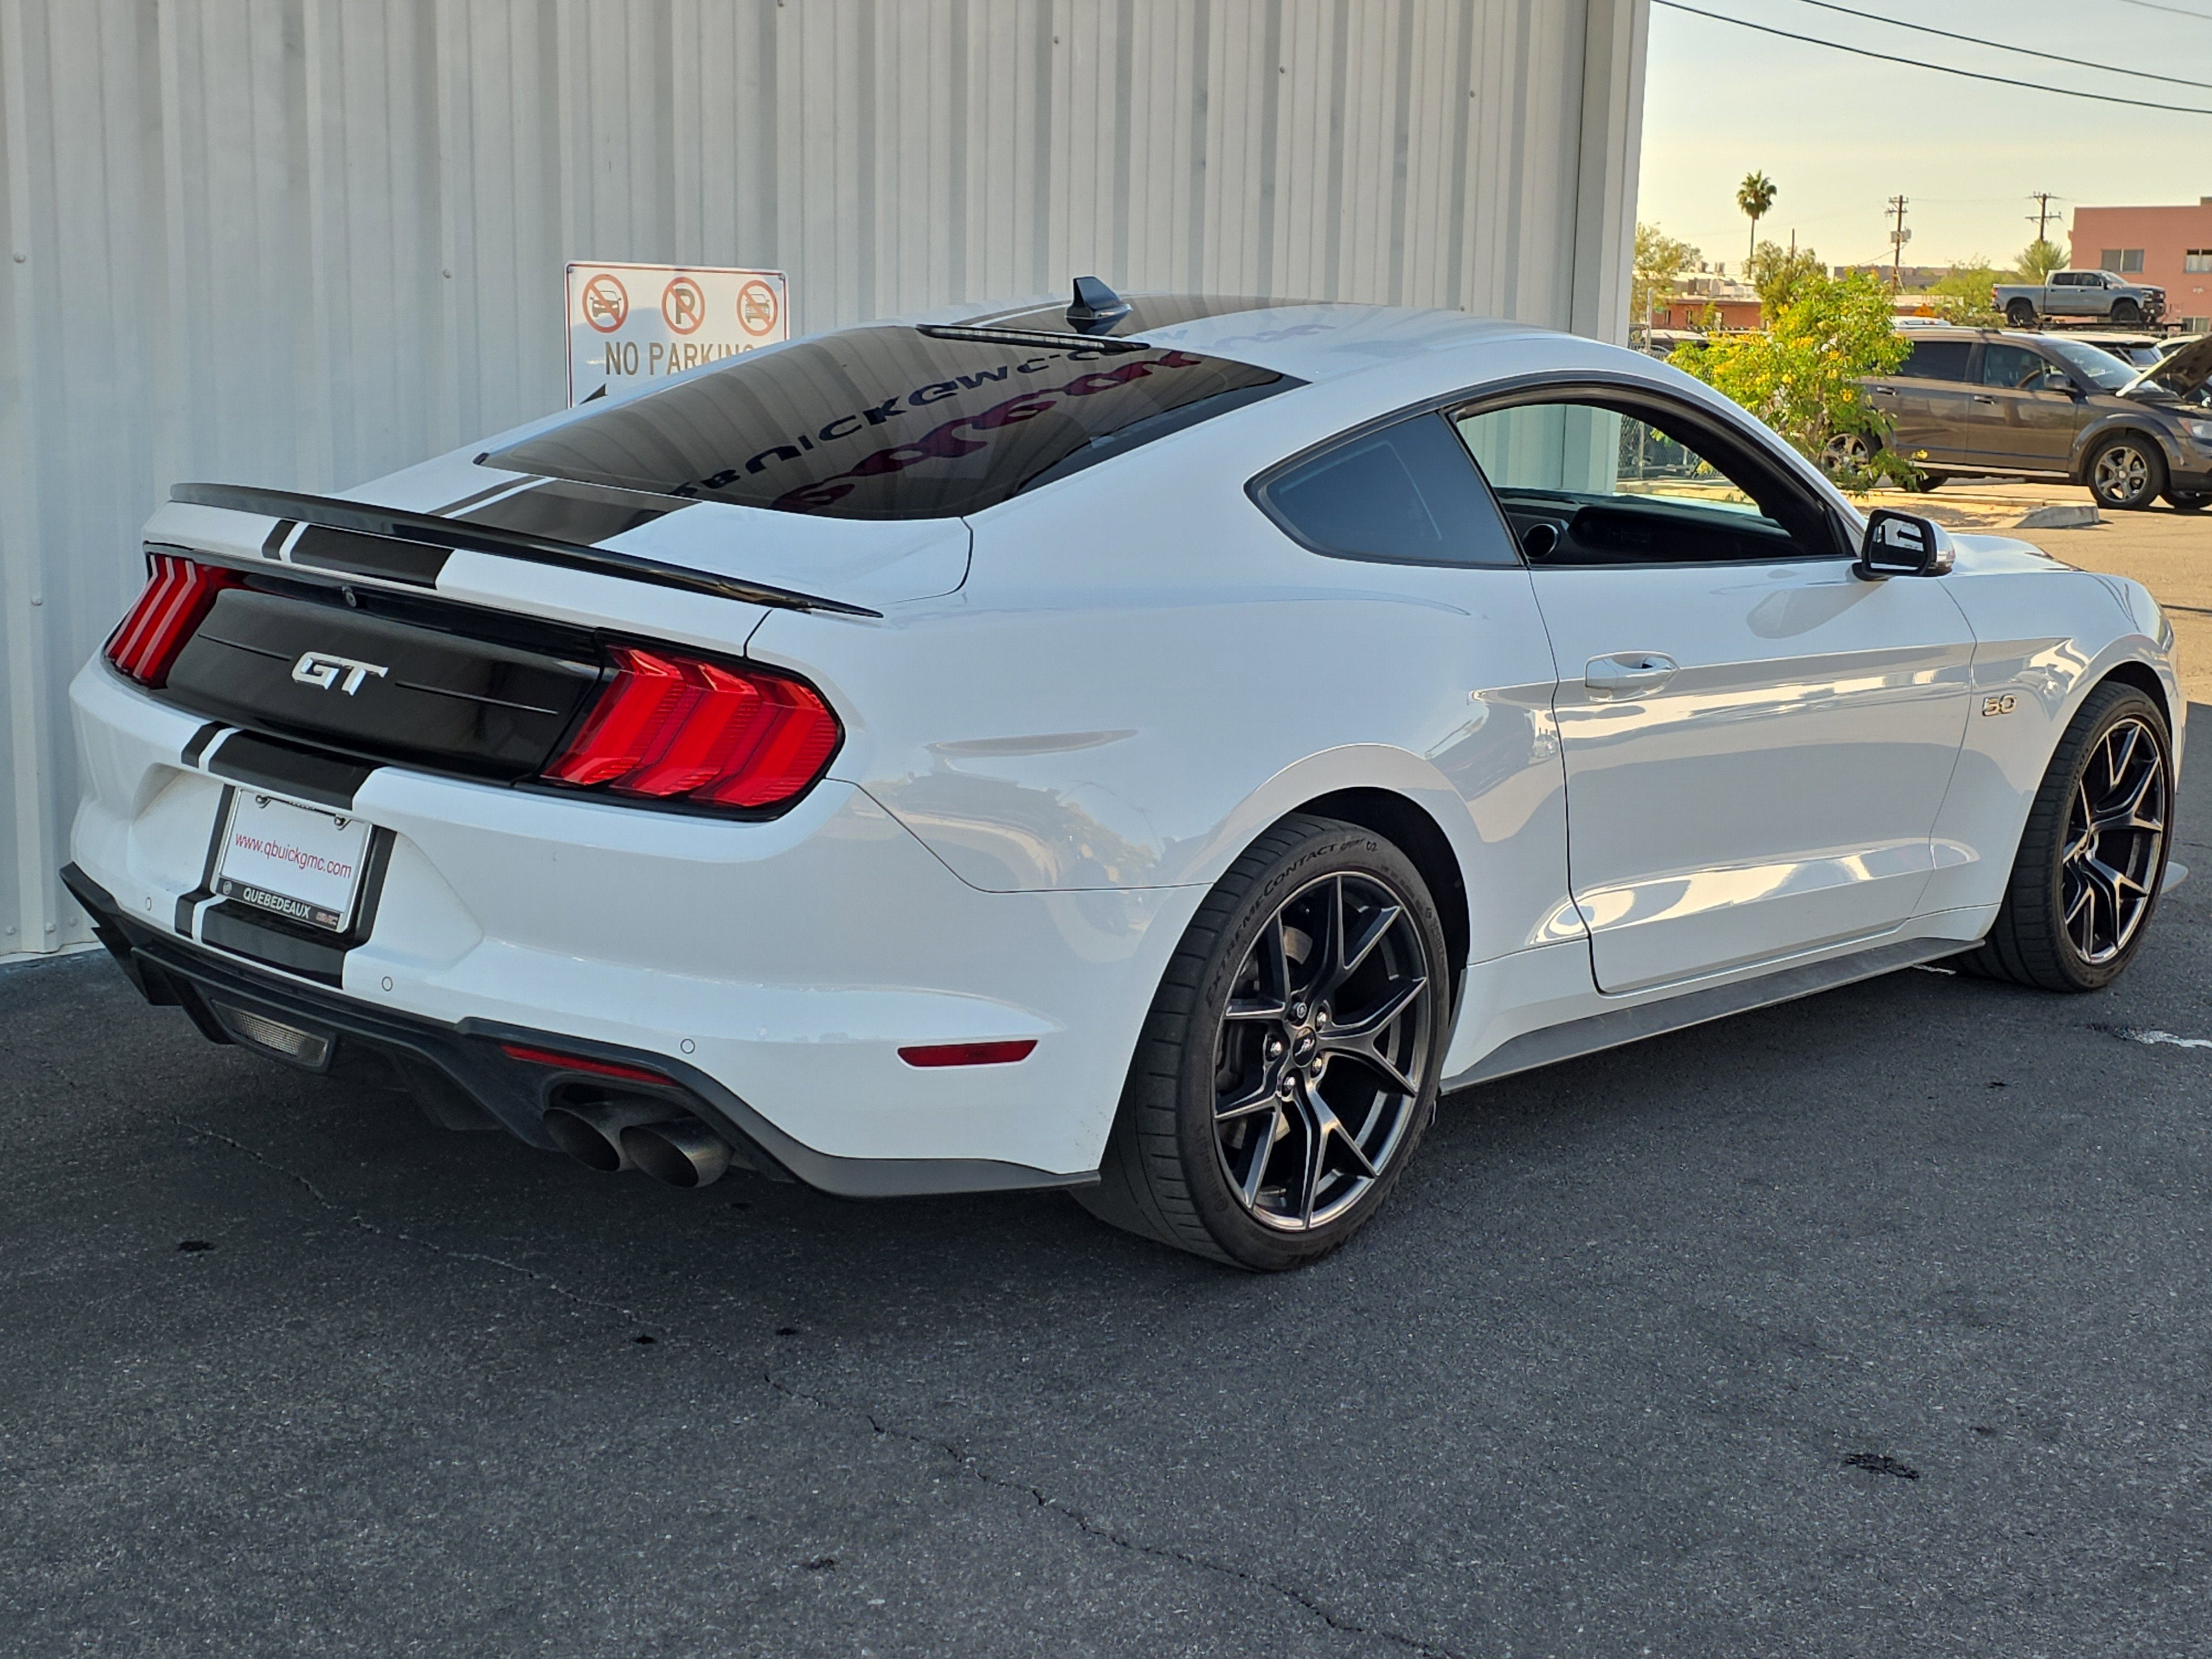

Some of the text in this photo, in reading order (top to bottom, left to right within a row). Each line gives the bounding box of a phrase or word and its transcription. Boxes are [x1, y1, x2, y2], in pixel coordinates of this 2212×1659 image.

[676, 288, 695, 324] P
[605, 341, 639, 376] NO
[291, 651, 389, 696] GT
[235, 833, 352, 878] www.qbuickgmc.com
[243, 887, 311, 919] QUEBEDEAUX
